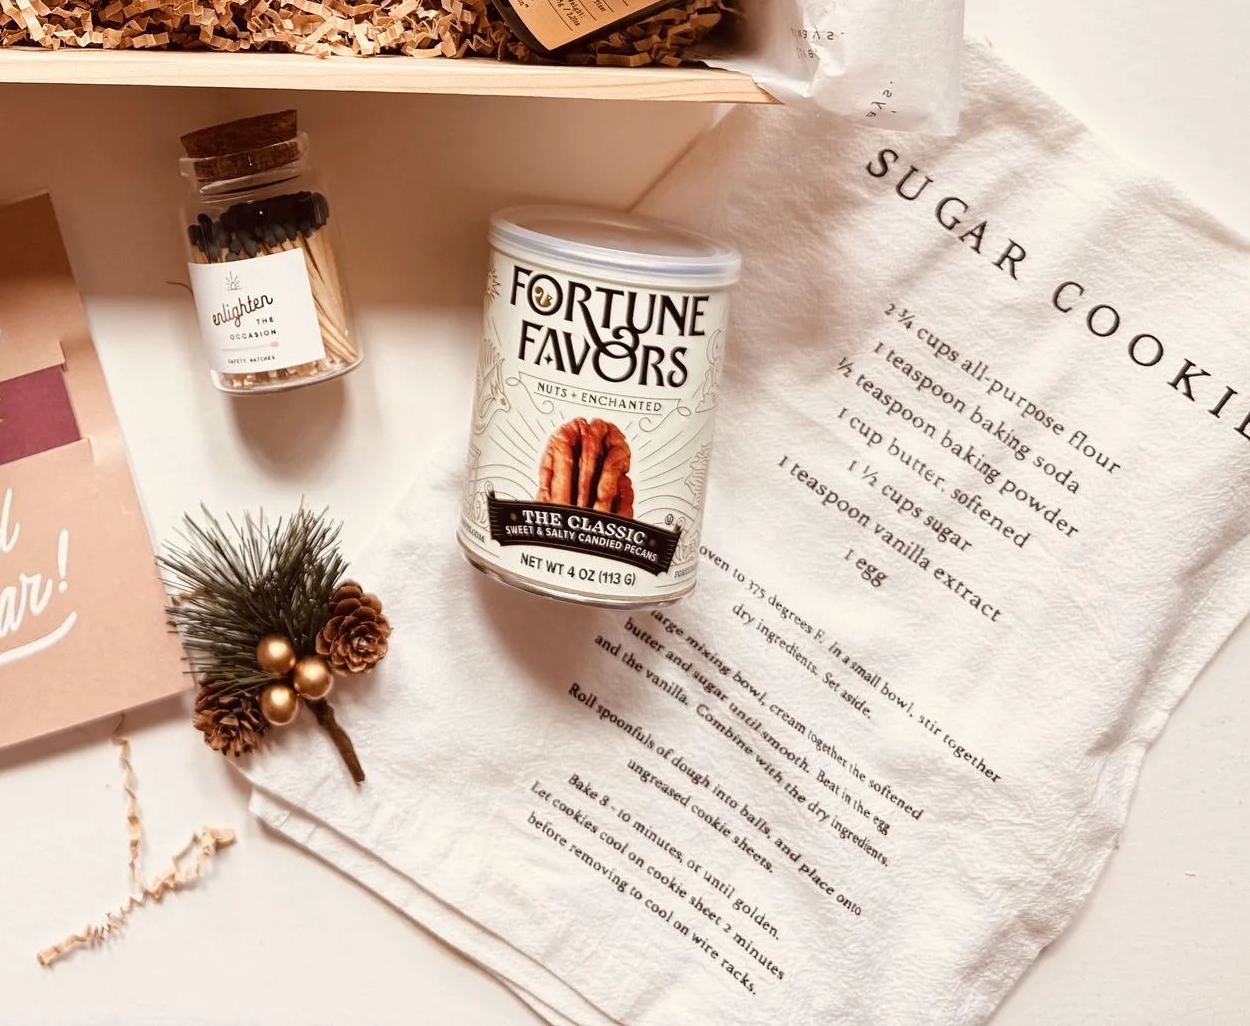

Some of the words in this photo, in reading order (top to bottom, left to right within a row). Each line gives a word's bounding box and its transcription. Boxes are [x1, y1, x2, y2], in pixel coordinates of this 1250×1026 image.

[865, 148, 1028, 281] SUGAR
[212, 295, 274, 328] enlighten
[229, 329, 277, 341] OCCASION
[256, 316, 274, 325] THE
[509, 265, 711, 340] FORTUNE
[517, 319, 689, 388] FAVORS
[537, 381, 568, 398] NUTS
[581, 392, 663, 412] ENCHANTED
[856, 374, 936, 439] teaspoon
[940, 429, 1001, 485] baking
[998, 479, 1079, 538] powder
[886, 350, 966, 414] teaspoon
[969, 405, 1031, 461] baking
[1033, 456, 1079, 494] soda
[917, 328, 959, 363] cups
[961, 360, 1065, 435] all-purpose
[1068, 430, 1121, 474] flour
[505, 525, 535, 536] SWEET
[536, 527, 543, 536] &
[545, 527, 576, 541] SALTY
[578, 532, 623, 551] CANDIED
[624, 542, 658, 562] PECANS
[522, 509, 563, 526] THE
[567, 515, 647, 545] CLASSIC
[790, 463, 871, 528] teaspoon
[874, 523, 931, 571] vanilla
[934, 568, 1001, 622] extract
[850, 417, 883, 447] cup
[950, 489, 1031, 548] softened
[882, 485, 923, 518] cups
[923, 516, 972, 551] sugar
[520, 552, 543, 571] NET
[545, 558, 565, 576] WT
[566, 562, 575, 578] 4
[578, 564, 595, 582] OZ
[598, 569, 621, 586] (113
[624, 571, 637, 586] G)
[856, 558, 888, 588] egg
[624, 617, 665, 652] butter
[665, 651, 693, 672] and
[692, 671, 728, 701] sugar
[729, 702, 762, 733] until
[760, 731, 809, 773] smooth.
[816, 769, 840, 795] Beat
[853, 800, 870, 818] the
[873, 816, 890, 836] egg
[699, 546, 729, 571] oven
[733, 568, 745, 582] to
[749, 580, 766, 599] 375
[768, 595, 814, 634] degrees
[842, 656, 850, 665] a
[850, 662, 881, 688] small
[918, 715, 942, 735] stir
[943, 734, 1001, 782] together
[733, 604, 755, 625] dry
[756, 619, 817, 676] ingredients.
[822, 672, 840, 692] Set
[840, 690, 870, 720] aside.
[595, 636, 621, 656] and
[622, 653, 643, 672] the
[646, 670, 688, 706] vanilla.
[696, 704, 755, 755] Combine
[756, 754, 783, 784] with
[784, 783, 806, 803] the
[808, 801, 830, 822] dry
[831, 815, 888, 867] ingredients.
[686, 636, 732, 676] mixing
[769, 705, 806, 735] cream
[849, 764, 866, 782] the
[868, 780, 924, 821] softened
[568, 683, 597, 708] Roll
[596, 705, 655, 750] spoonfuls
[656, 747, 674, 760] of
[671, 756, 710, 788] dough
[712, 784, 739, 809] into
[740, 804, 771, 839] balls,
[774, 838, 802, 863] and
[798, 863, 834, 895] place
[836, 894, 862, 916] onto
[568, 773, 598, 800] Bake
[687, 860, 702, 873] or
[703, 871, 735, 899] until
[732, 898, 779, 940] golden.
[627, 760, 691, 808] ungreased
[691, 805, 731, 837] cookie
[732, 836, 773, 873] sheets.
[528, 811, 567, 846] before
[569, 844, 629, 894] removing
[630, 886, 642, 900] to
[645, 899, 674, 923] cool
[673, 921, 690, 936] on
[692, 932, 719, 959] wire
[720, 959, 756, 995] racks.
[552, 799, 598, 834] cookies
[600, 832, 629, 854] cool
[628, 852, 645, 868] on
[647, 866, 687, 898] cookie
[689, 896, 722, 926] sheet
[732, 932, 784, 980] minutes
